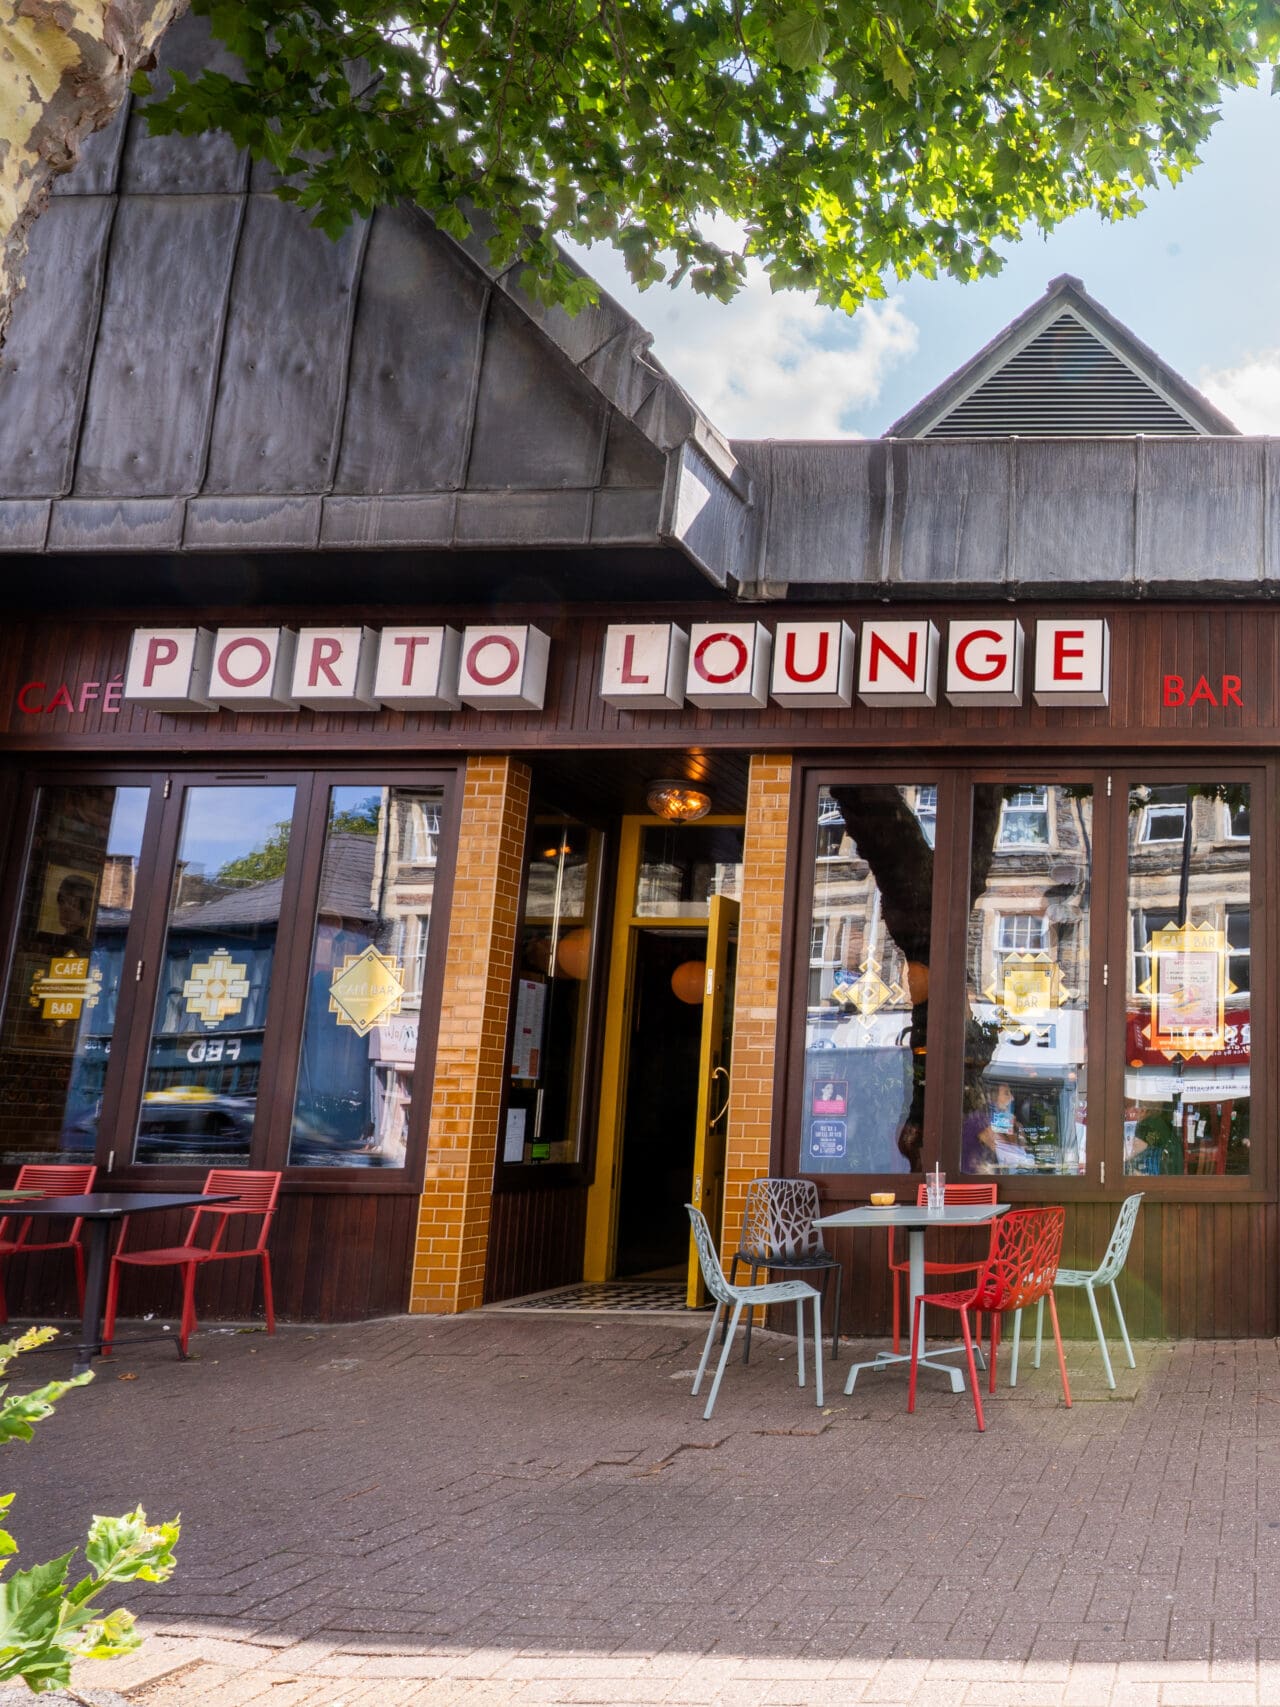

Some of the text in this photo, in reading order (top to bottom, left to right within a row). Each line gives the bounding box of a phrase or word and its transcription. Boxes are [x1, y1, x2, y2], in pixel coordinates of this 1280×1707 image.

[142, 629, 1085, 688] PORTO LOUNGE
[17, 674, 125, 713] CAFÉ
[1163, 674, 1244, 708] BAR
[1193, 935, 1216, 948] BAR
[54, 960, 85, 975] CAFÉ
[50, 1002, 73, 1015] BAR
[1016, 996, 1039, 1008] BAR
